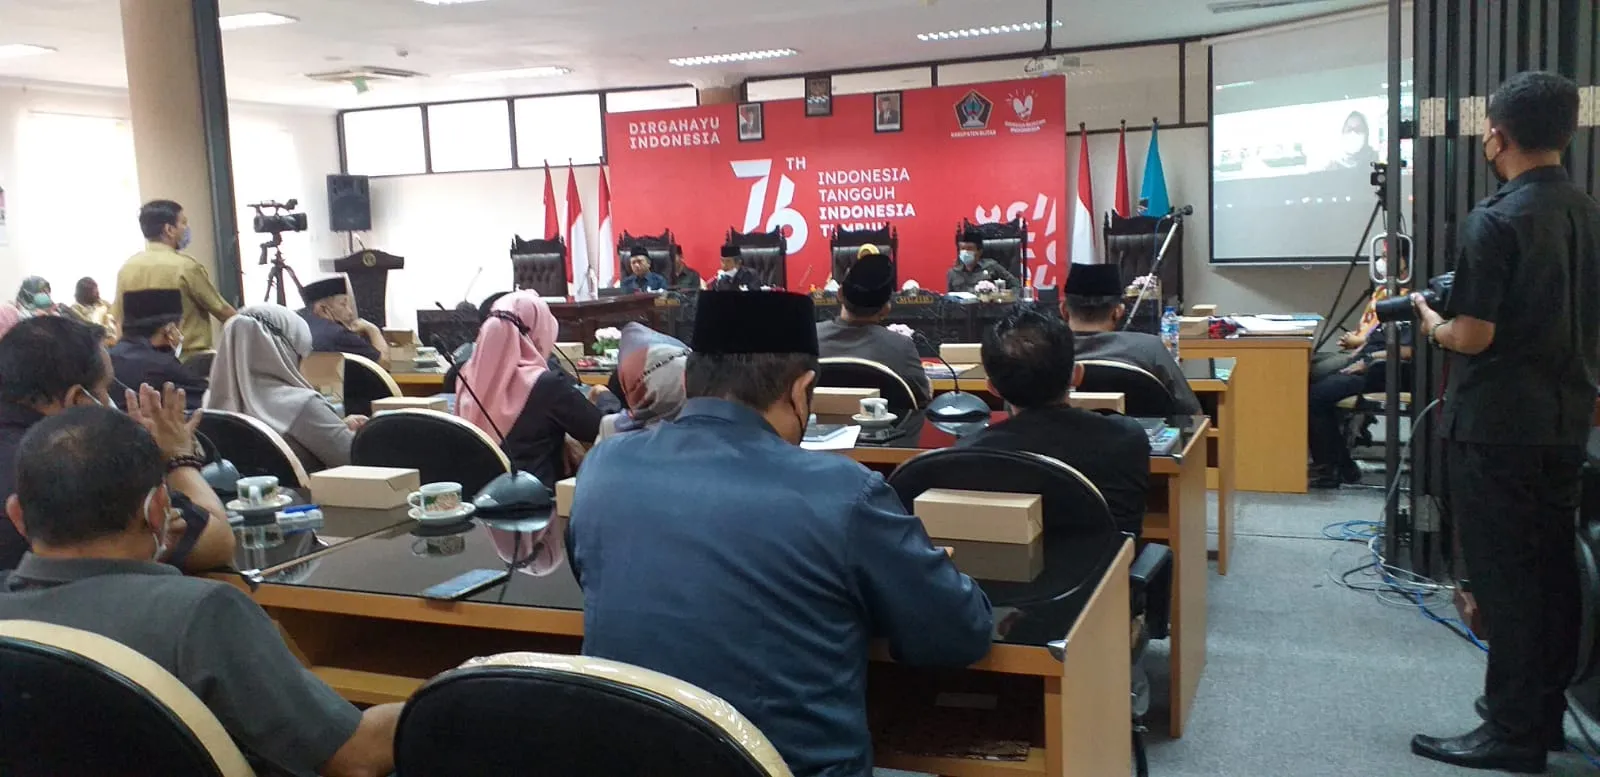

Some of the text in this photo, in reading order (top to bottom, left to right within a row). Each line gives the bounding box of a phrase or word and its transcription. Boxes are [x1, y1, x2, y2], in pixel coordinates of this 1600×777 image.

[629, 117, 720, 135] DIRGAHAYU
[629, 132, 720, 149] INDONESIA
[786, 156, 807, 171] TH
[817, 167, 910, 186] INDONESIA
[818, 186, 895, 203] TANGGUH
[818, 203, 916, 220] INDONESIA
